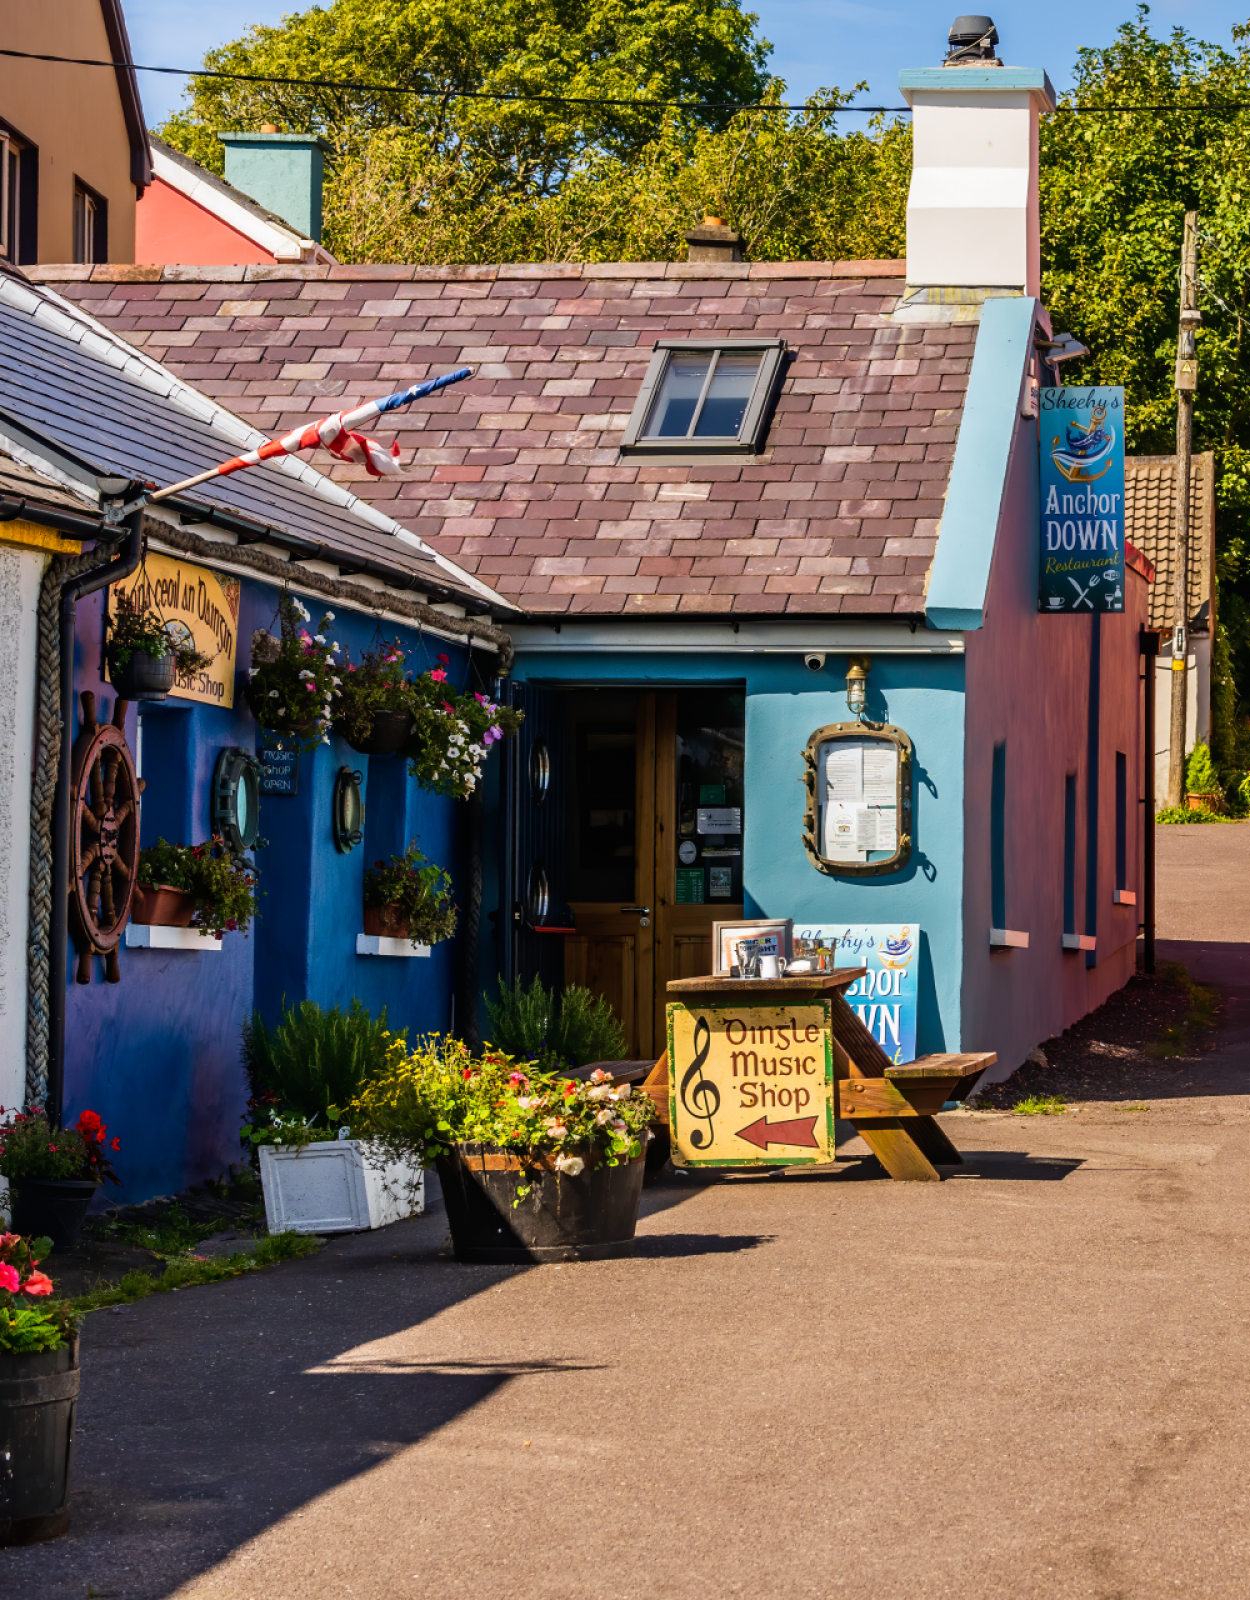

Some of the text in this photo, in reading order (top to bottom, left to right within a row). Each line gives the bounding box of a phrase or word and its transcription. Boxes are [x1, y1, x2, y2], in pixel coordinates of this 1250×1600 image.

[1042, 387, 1121, 412] Sheehy's
[1045, 485, 1121, 517] Anchor
[1046, 520, 1118, 551] DOWN
[1046, 551, 1121, 575] Restaurant
[199, 673, 225, 702] Shop
[722, 1017, 820, 1051] Dingle
[730, 1051, 816, 1077] Music
[740, 1082, 810, 1114] Shop
